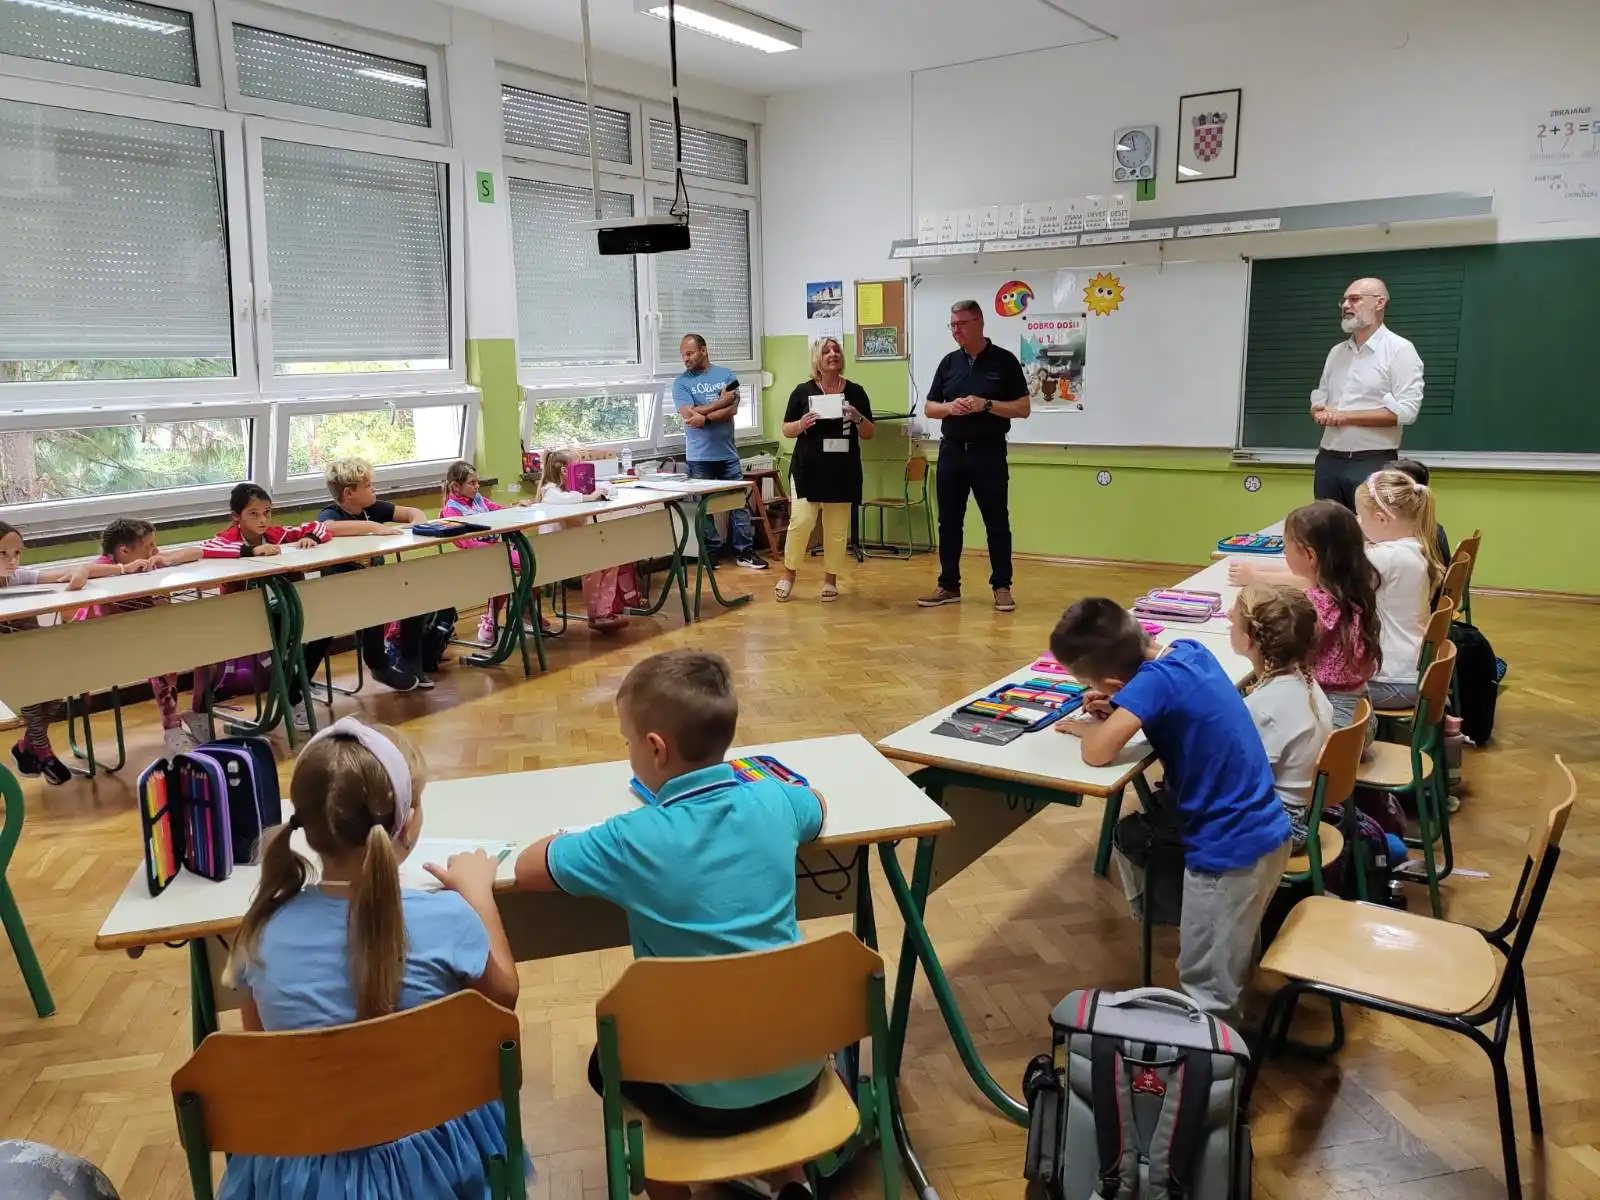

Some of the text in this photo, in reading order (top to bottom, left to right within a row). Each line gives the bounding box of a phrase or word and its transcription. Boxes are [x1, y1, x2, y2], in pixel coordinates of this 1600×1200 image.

[1537, 124, 1547, 138] 2
[1550, 125, 1561, 135] +
[1564, 122, 1574, 136] 3
[1579, 123, 1589, 132] =
[481, 179, 490, 197] S
[1027, 322, 1055, 330] DOBRO
